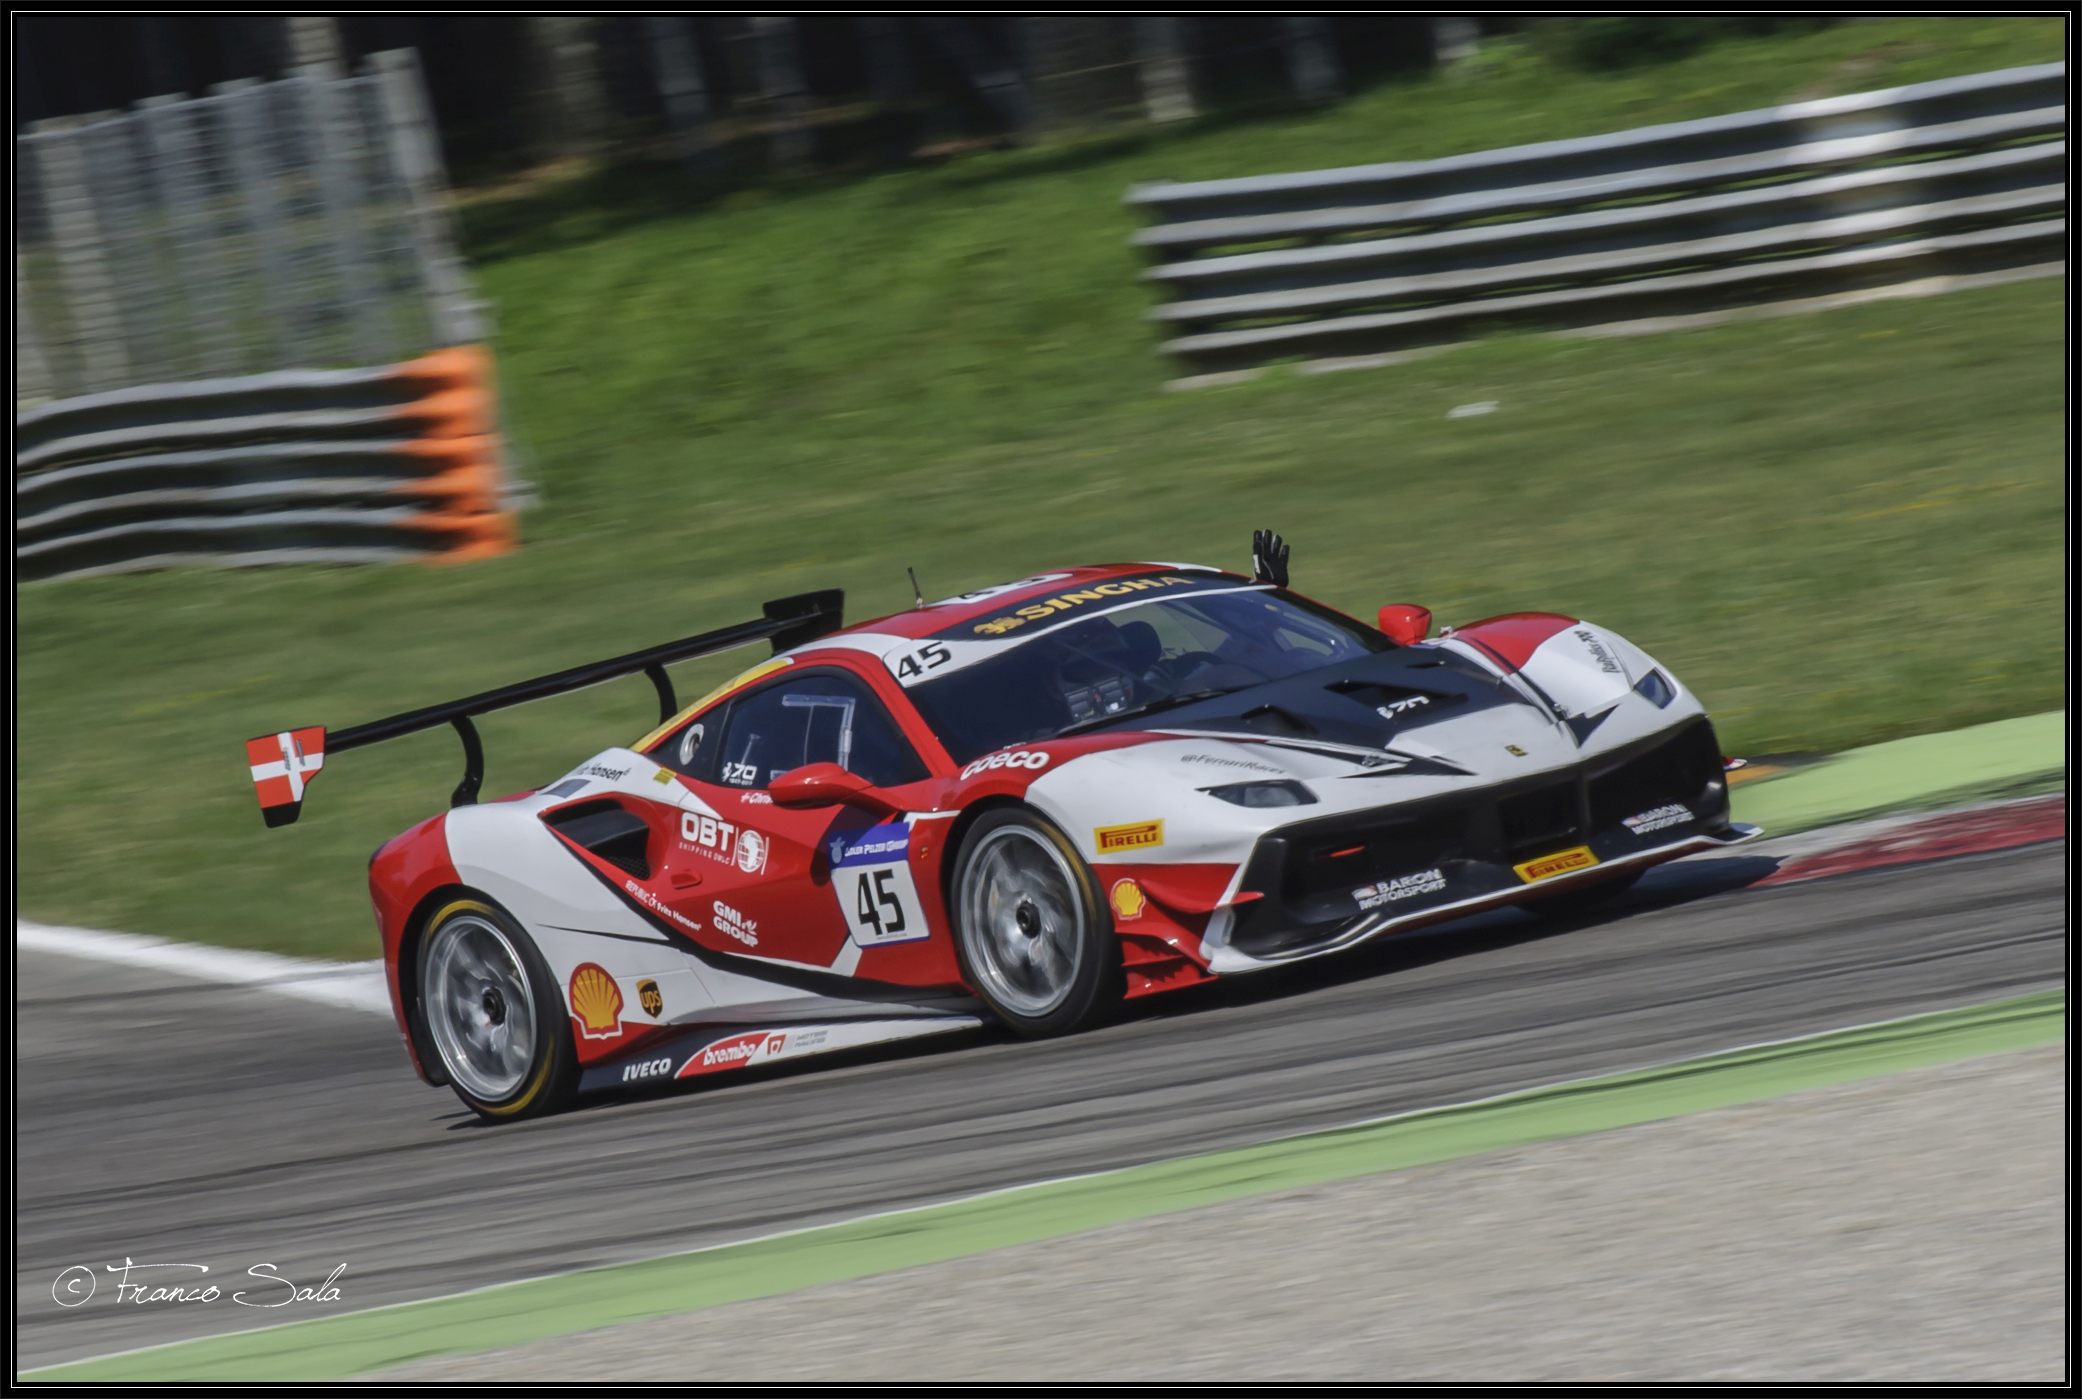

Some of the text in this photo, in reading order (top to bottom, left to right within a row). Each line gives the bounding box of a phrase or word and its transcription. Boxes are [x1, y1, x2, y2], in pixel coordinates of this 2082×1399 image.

[1015, 576, 1196, 621] SINGHA
[898, 642, 951, 680] 45
[681, 811, 735, 852] OBT
[1099, 824, 1160, 849] PIRELLI
[678, 841, 713, 860] SHIPPING
[1524, 851, 1591, 879] PIRELLI
[625, 880, 651, 903] REPUBLIC
[1358, 878, 1446, 910] MOTORSPORT
[1375, 868, 1443, 894] BARON
[713, 900, 742, 927] GMI
[857, 868, 906, 936] 45
[713, 916, 758, 947] GROUP
[640, 990, 662, 1014] ups
[703, 1041, 755, 1066] brembo
[622, 1057, 672, 1081] IVECO
